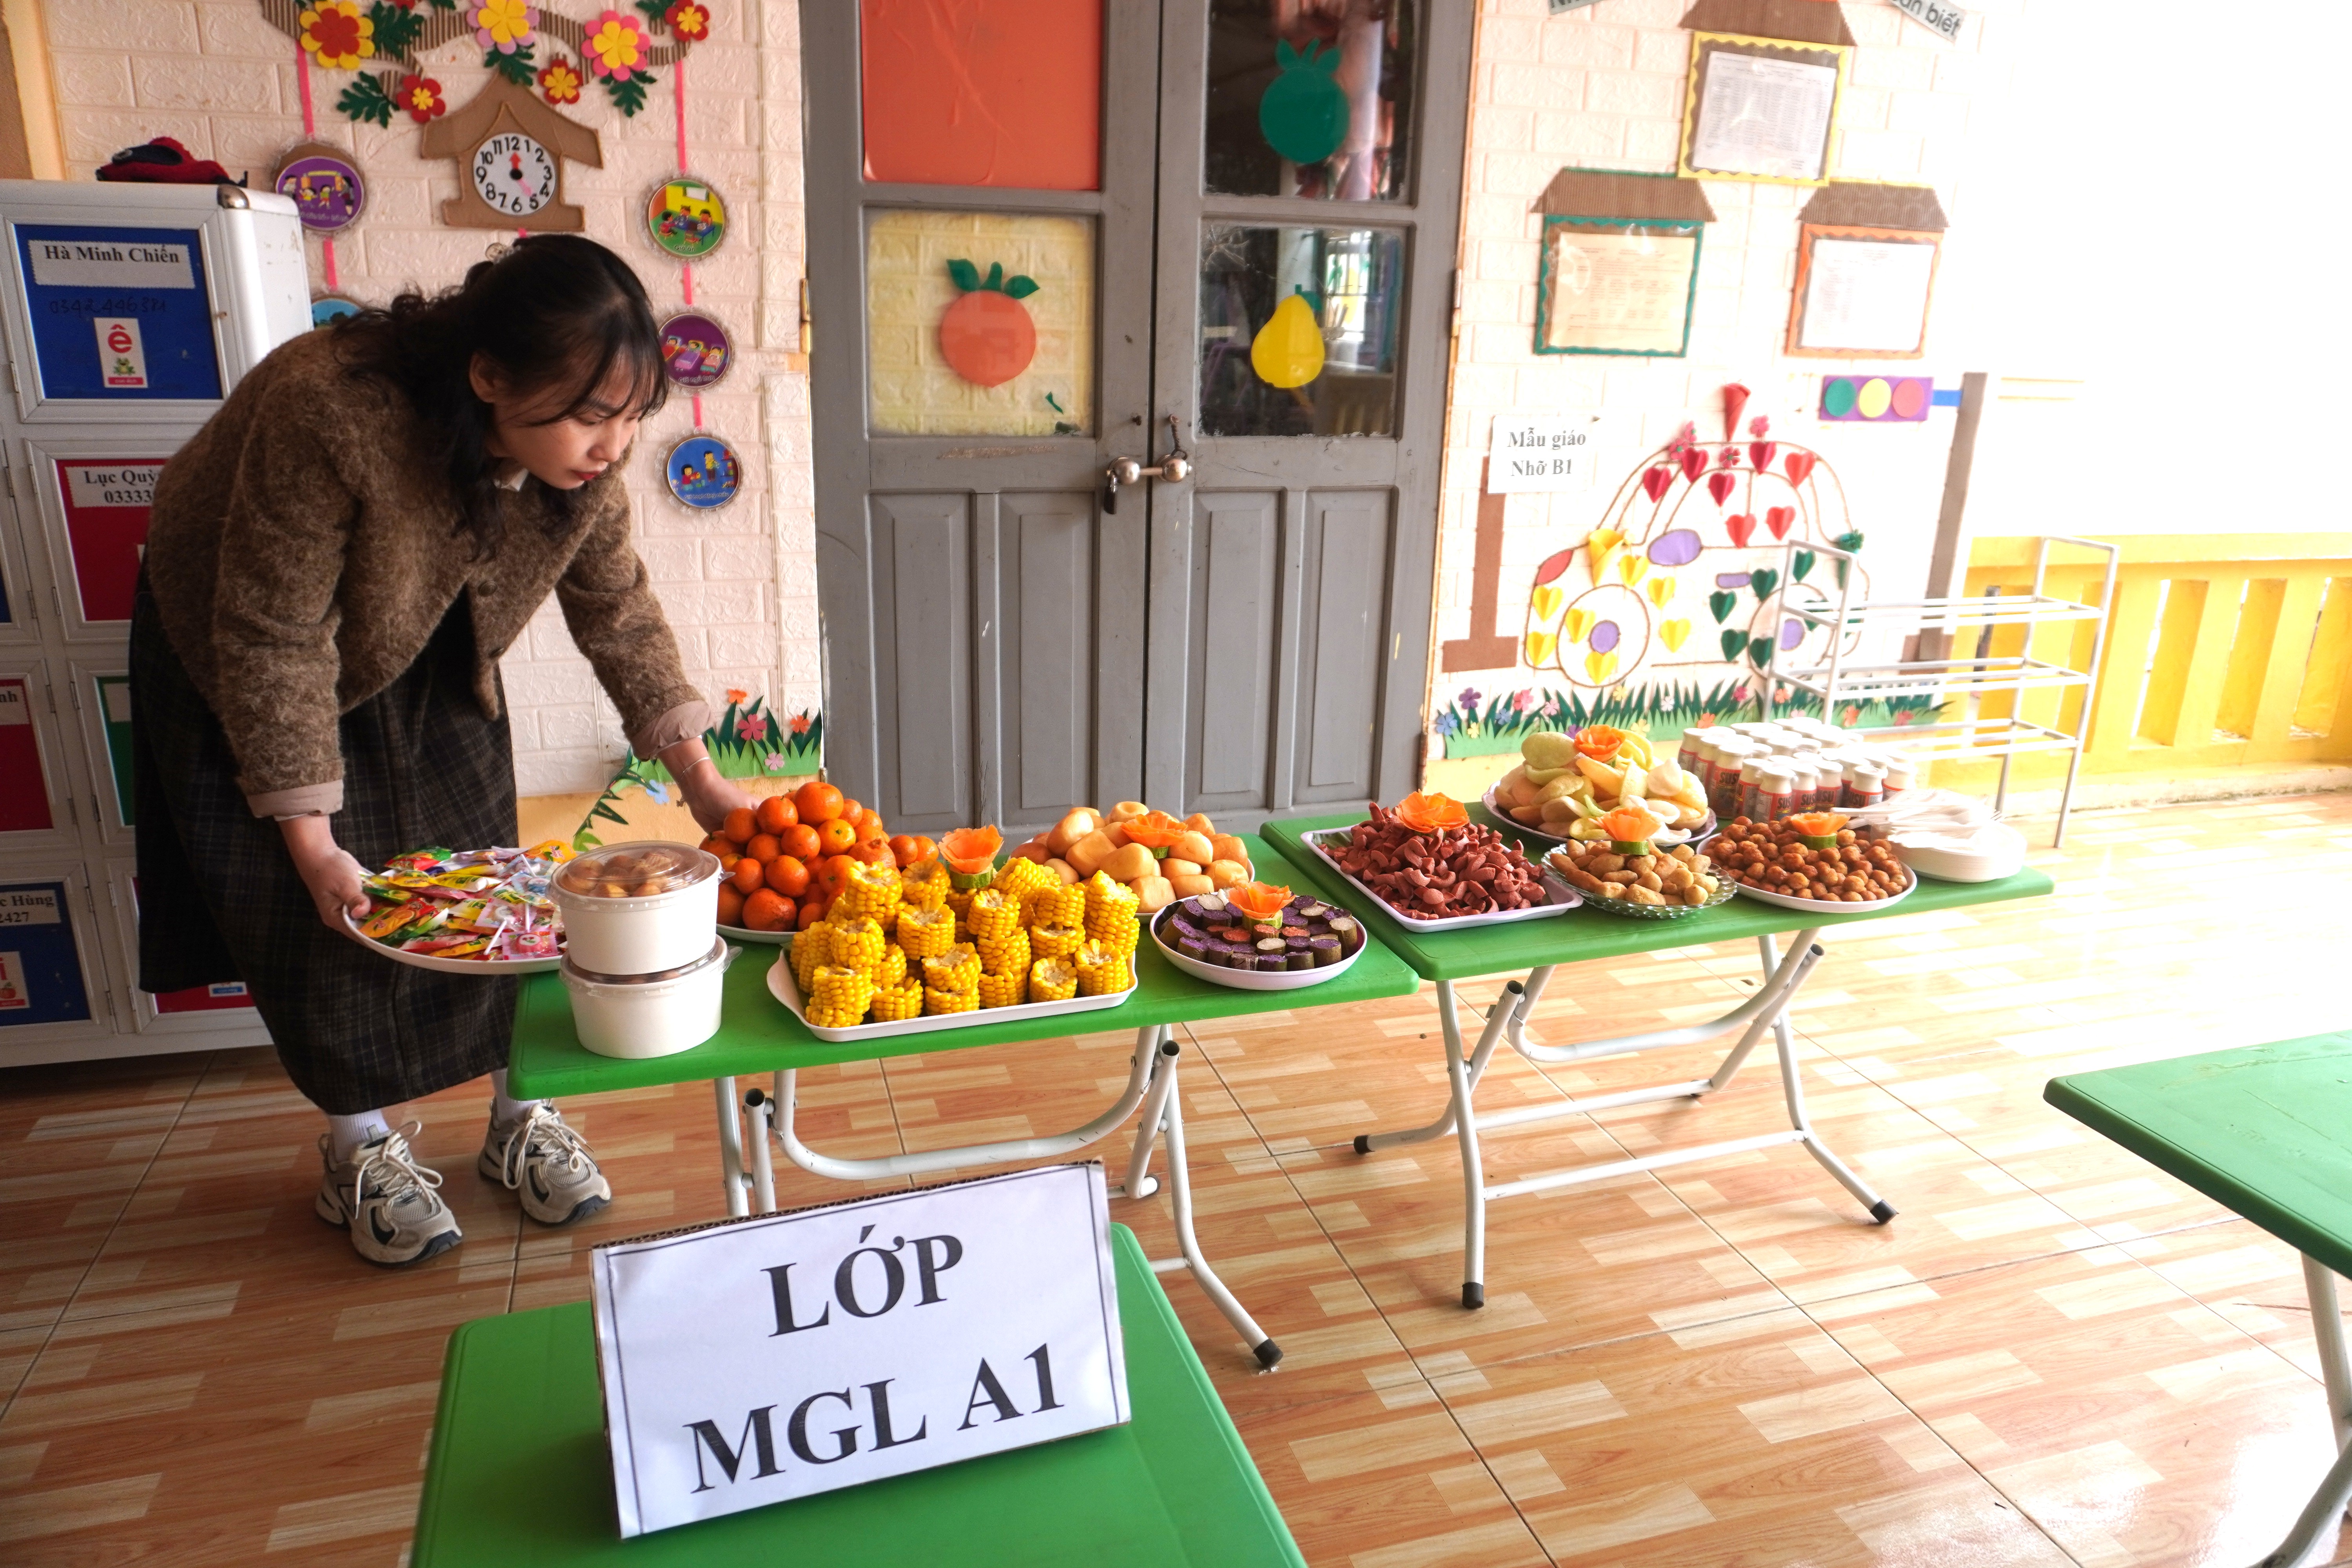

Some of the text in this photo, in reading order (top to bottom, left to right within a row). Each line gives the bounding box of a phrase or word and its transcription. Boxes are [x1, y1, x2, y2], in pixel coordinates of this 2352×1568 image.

[1925, 2, 1960, 36] biết
[492, 140, 502, 155] 11
[505, 136, 519, 151] 12
[524, 140, 530, 152] 1
[480, 151, 493, 165] 10
[535, 147, 544, 163] 2
[475, 165, 486, 184] 9
[543, 165, 552, 180] 3
[486, 182, 495, 200] 8
[539, 181, 549, 197] 4
[498, 192, 506, 208] 7
[511, 196, 522, 212] 6
[529, 193, 539, 210] 5
[44, 244, 180, 263] Hà Minh Chiến
[108, 324, 133, 354] ê
[1507, 427, 1586, 450] Mẫu giáo
[1510, 459, 1572, 476] Nhỡ B1
[84, 469, 157, 486] Lục Quỳ
[104, 490, 152, 503] 03333
[0, 690, 18, 702] nh
[1719, 771, 1740, 784] SUS
[1777, 795, 1793, 809] SUS
[1801, 793, 1816, 805] SUS
[11, 895, 54, 907] Hùng
[760, 1224, 964, 1338] LỚP
[682, 1343, 1065, 1494] MGL A1
